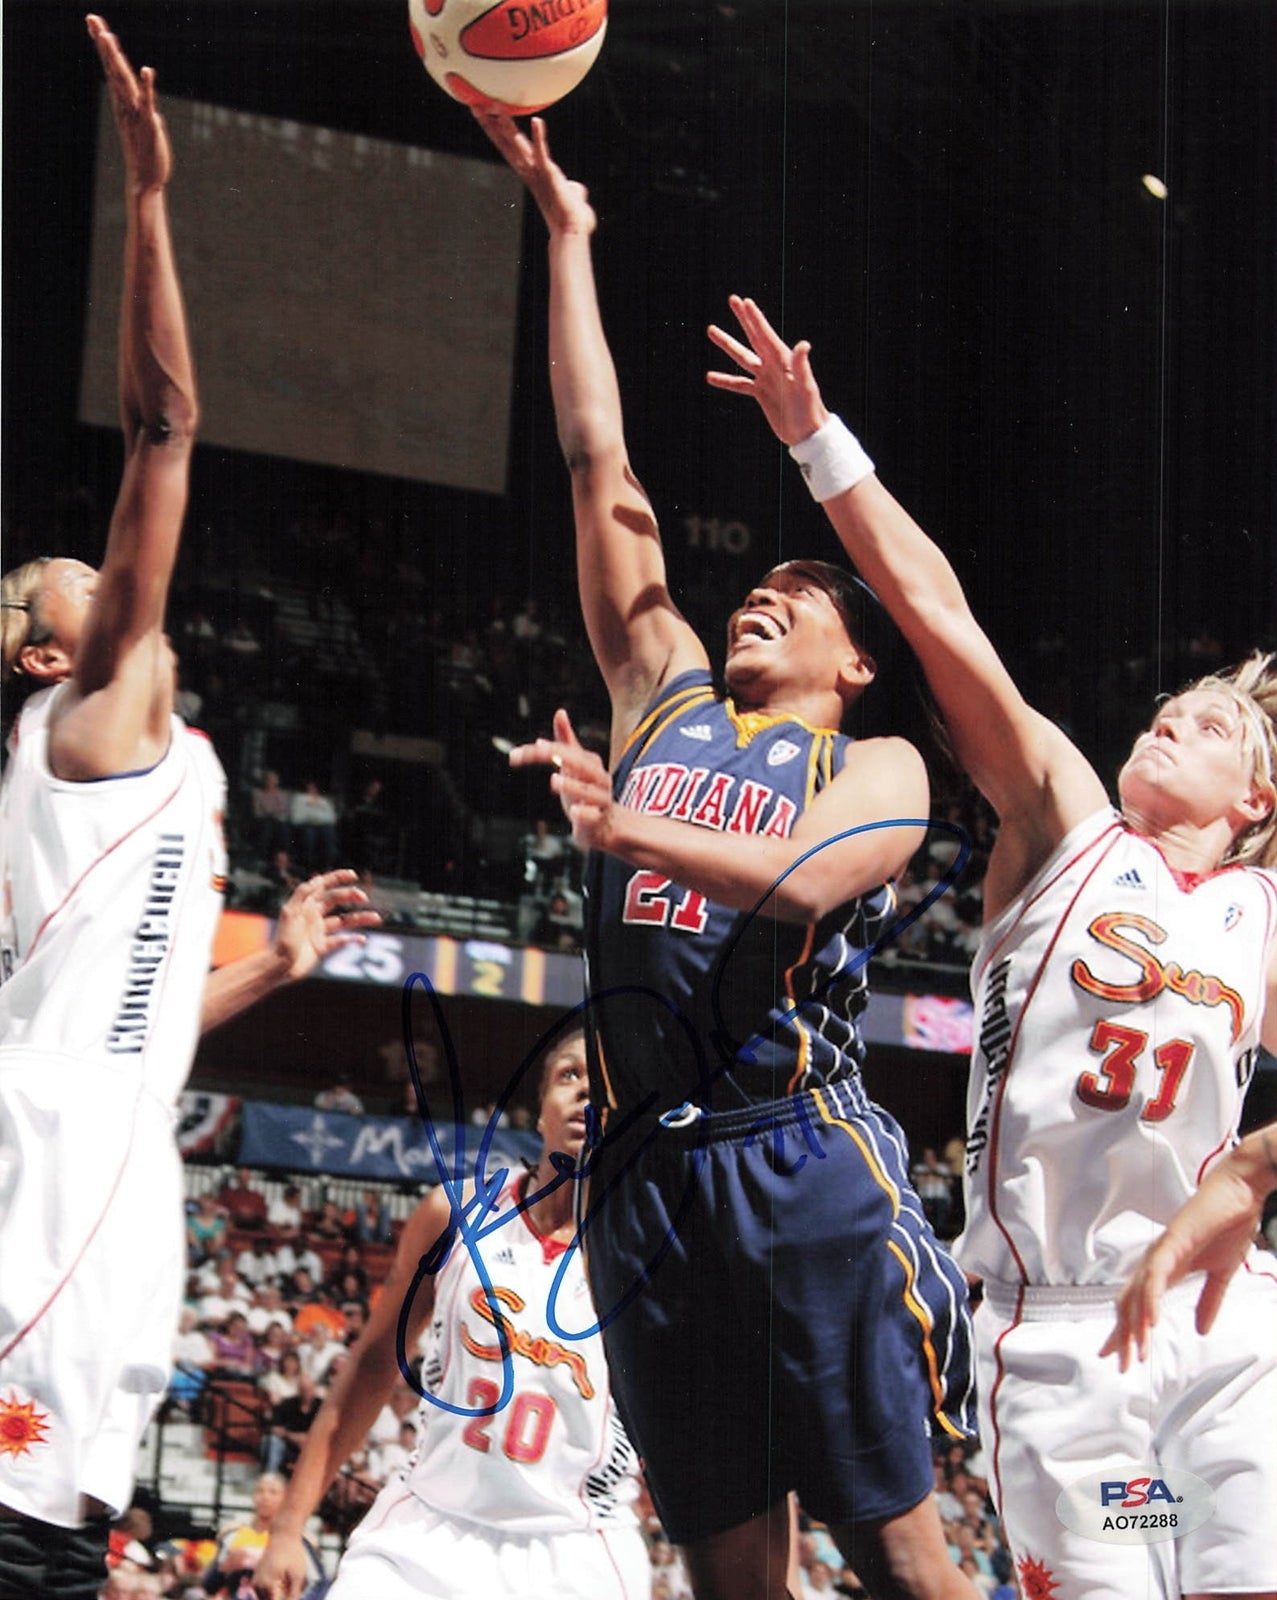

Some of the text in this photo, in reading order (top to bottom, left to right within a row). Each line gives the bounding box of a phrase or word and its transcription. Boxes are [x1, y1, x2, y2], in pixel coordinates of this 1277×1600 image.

[685, 516, 750, 553] 110
[622, 869, 709, 934] 21
[1071, 911, 1245, 1044] Sun
[1077, 1020, 1196, 1121] 31
[460, 1286, 595, 1399] Sun
[462, 1377, 557, 1465] 20
